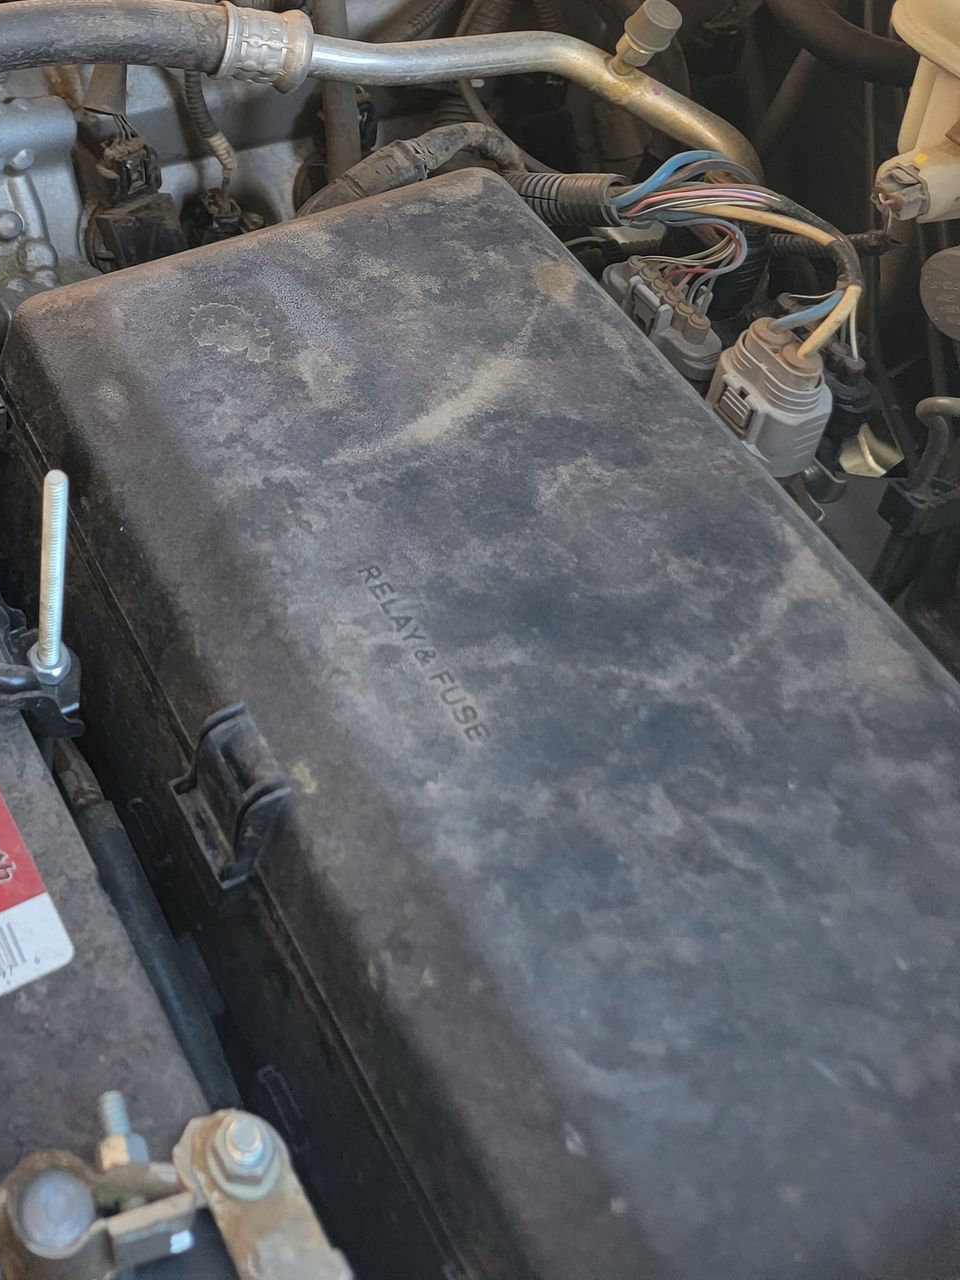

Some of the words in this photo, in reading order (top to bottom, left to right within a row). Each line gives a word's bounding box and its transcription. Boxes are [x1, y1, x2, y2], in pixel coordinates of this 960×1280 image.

[358, 565, 427, 641] RELAY
[414, 648, 437, 667] &
[429, 670, 490, 741] FUSE
